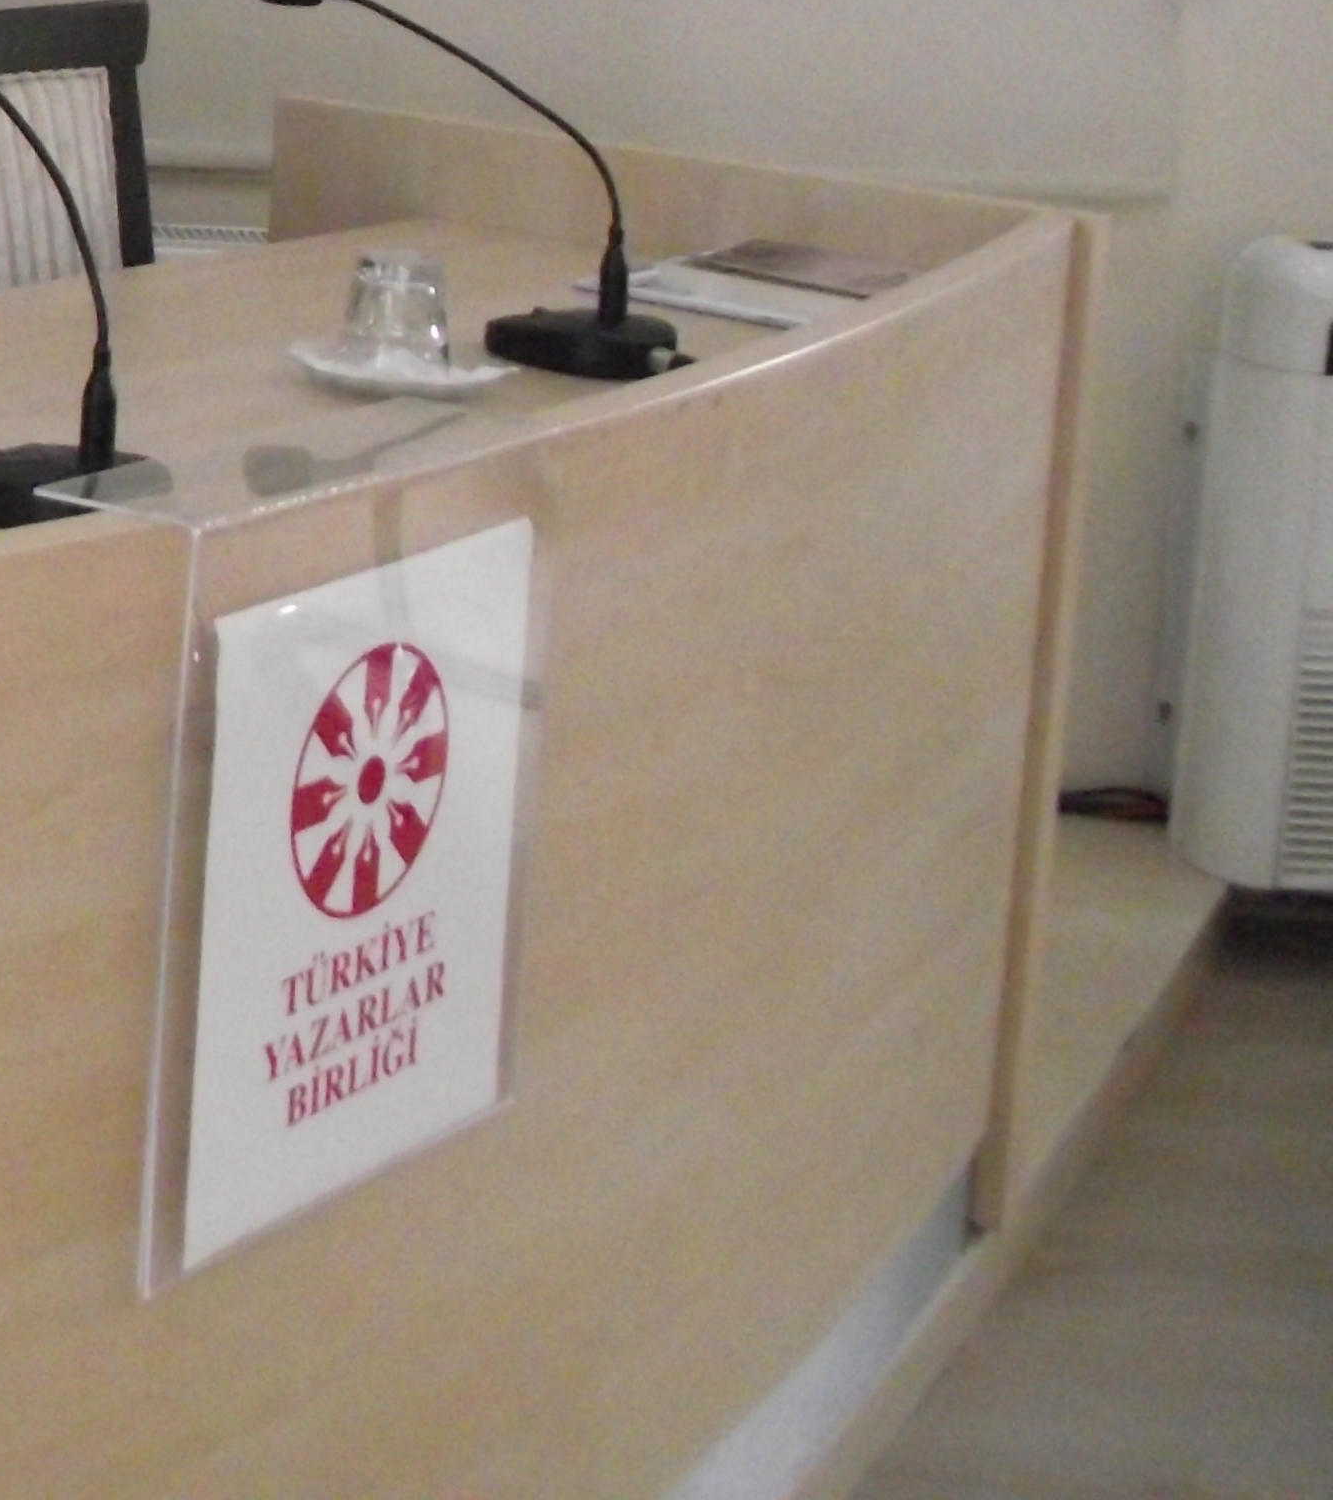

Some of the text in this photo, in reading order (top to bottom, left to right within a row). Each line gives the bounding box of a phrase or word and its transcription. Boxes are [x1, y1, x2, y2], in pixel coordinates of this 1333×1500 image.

[283, 910, 435, 1016] TÜRKİYE
[264, 961, 445, 1081] YAZARLAR
[287, 1016, 418, 1127] BİRLİĞİ
